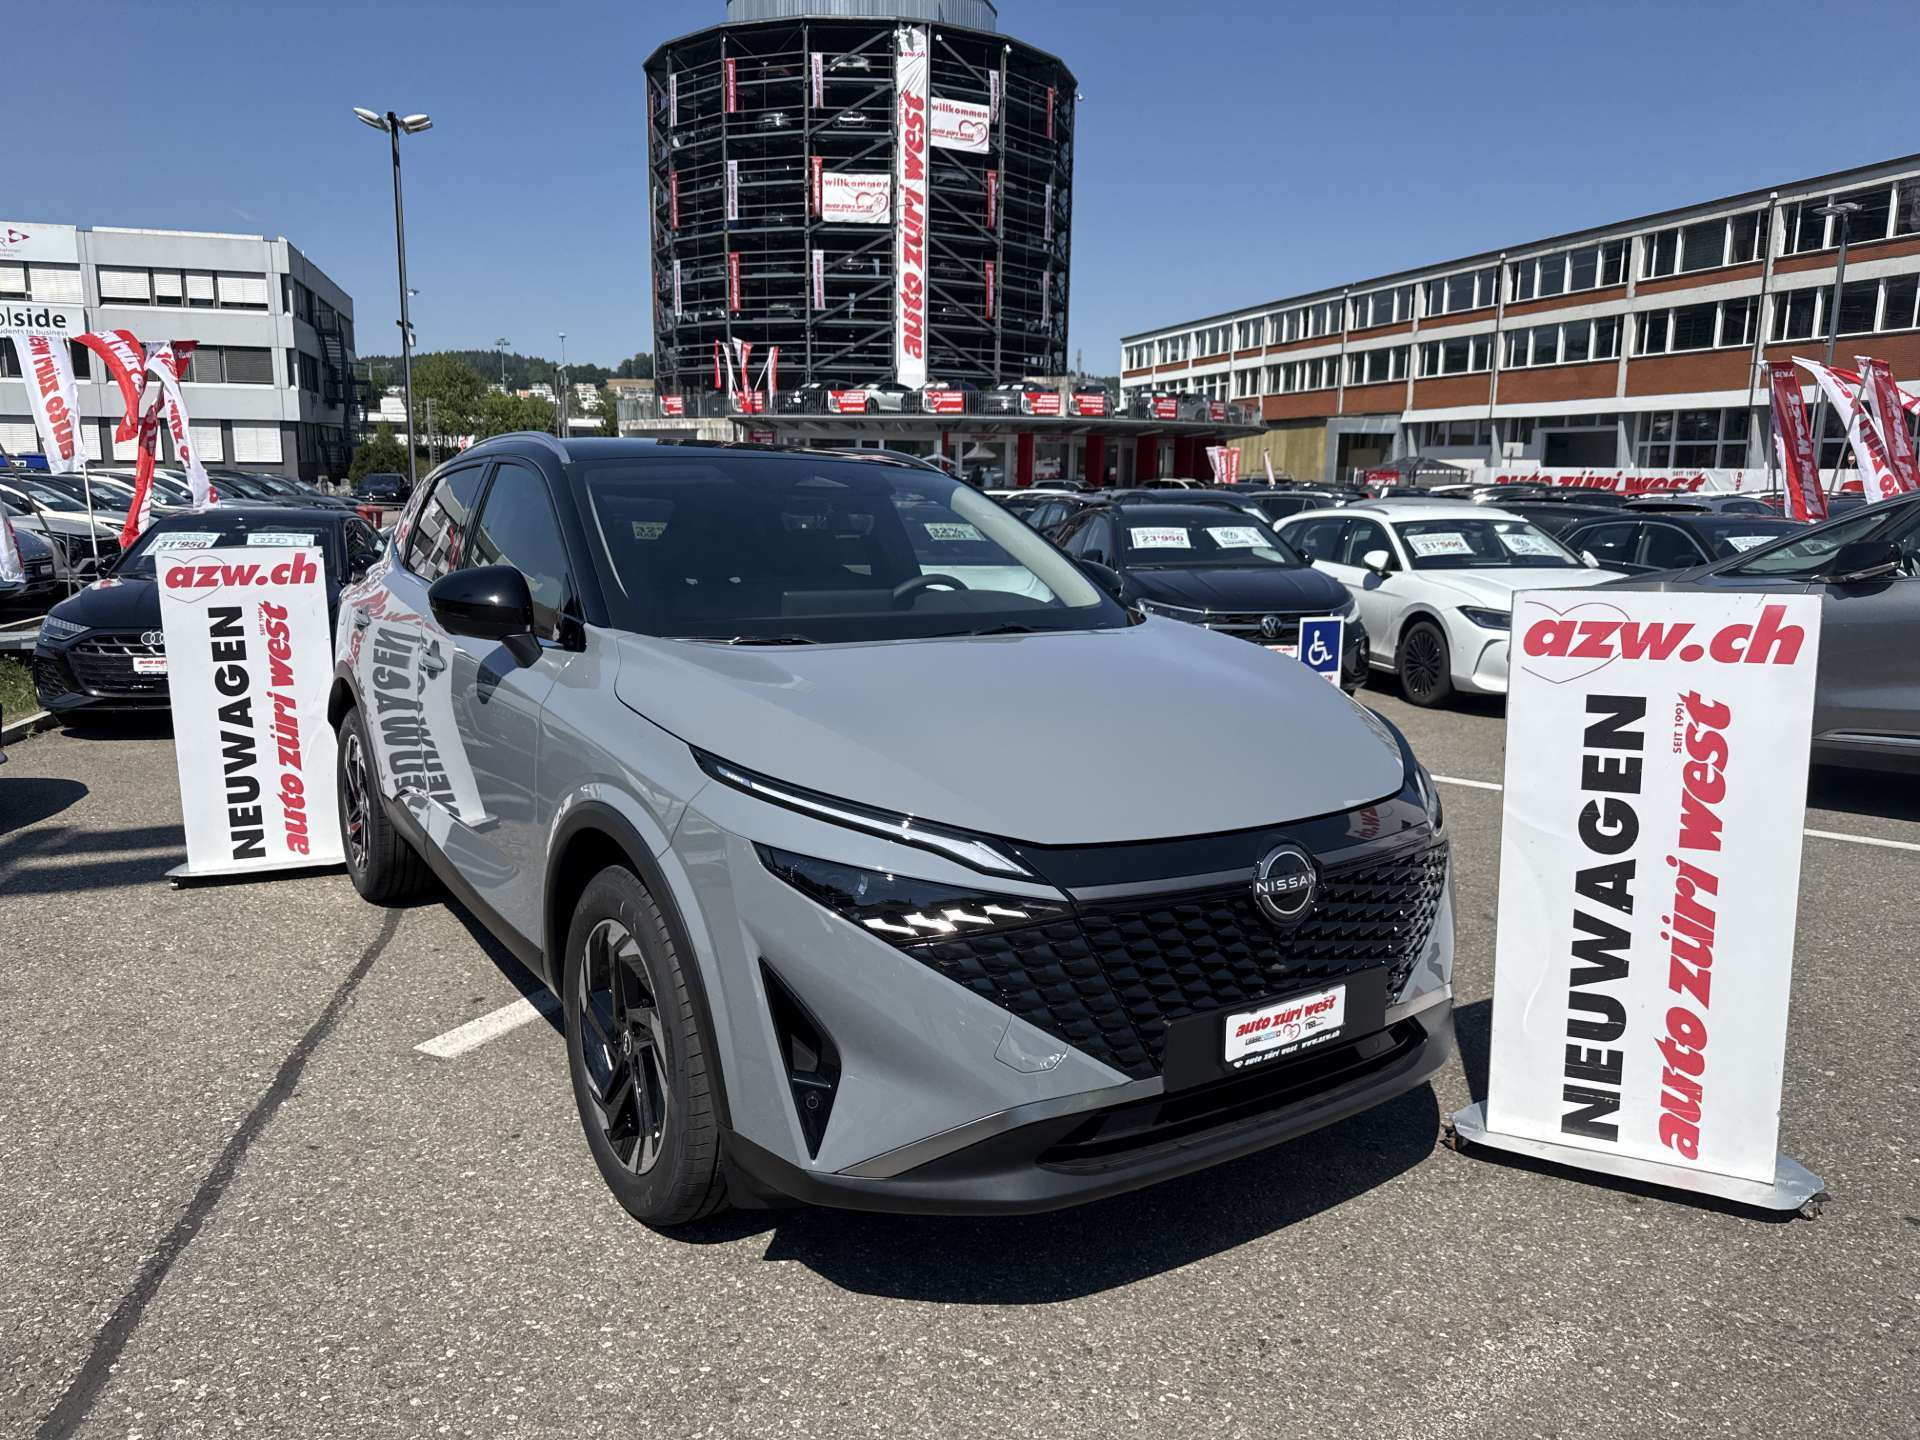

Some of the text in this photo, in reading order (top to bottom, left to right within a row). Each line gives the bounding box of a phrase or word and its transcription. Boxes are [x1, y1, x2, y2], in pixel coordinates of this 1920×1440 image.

[931, 102, 988, 119] willkommen
[899, 89, 925, 360] auto züri west
[165, 553, 317, 589] azw.ch
[1523, 605, 1805, 666] azw.ch
[208, 606, 267, 860] NEUWAGEN
[258, 600, 310, 856] auto züri west
[1673, 703, 1685, 754] SEIT 1991
[1256, 872, 1316, 893] NISSAN
[1561, 694, 1647, 1143] NEUWAGEN
[1654, 690, 1731, 1161] auto züri west
[1236, 1016, 1272, 1038] auto
[1271, 1005, 1304, 1028] züri
[1304, 995, 1336, 1018] west
